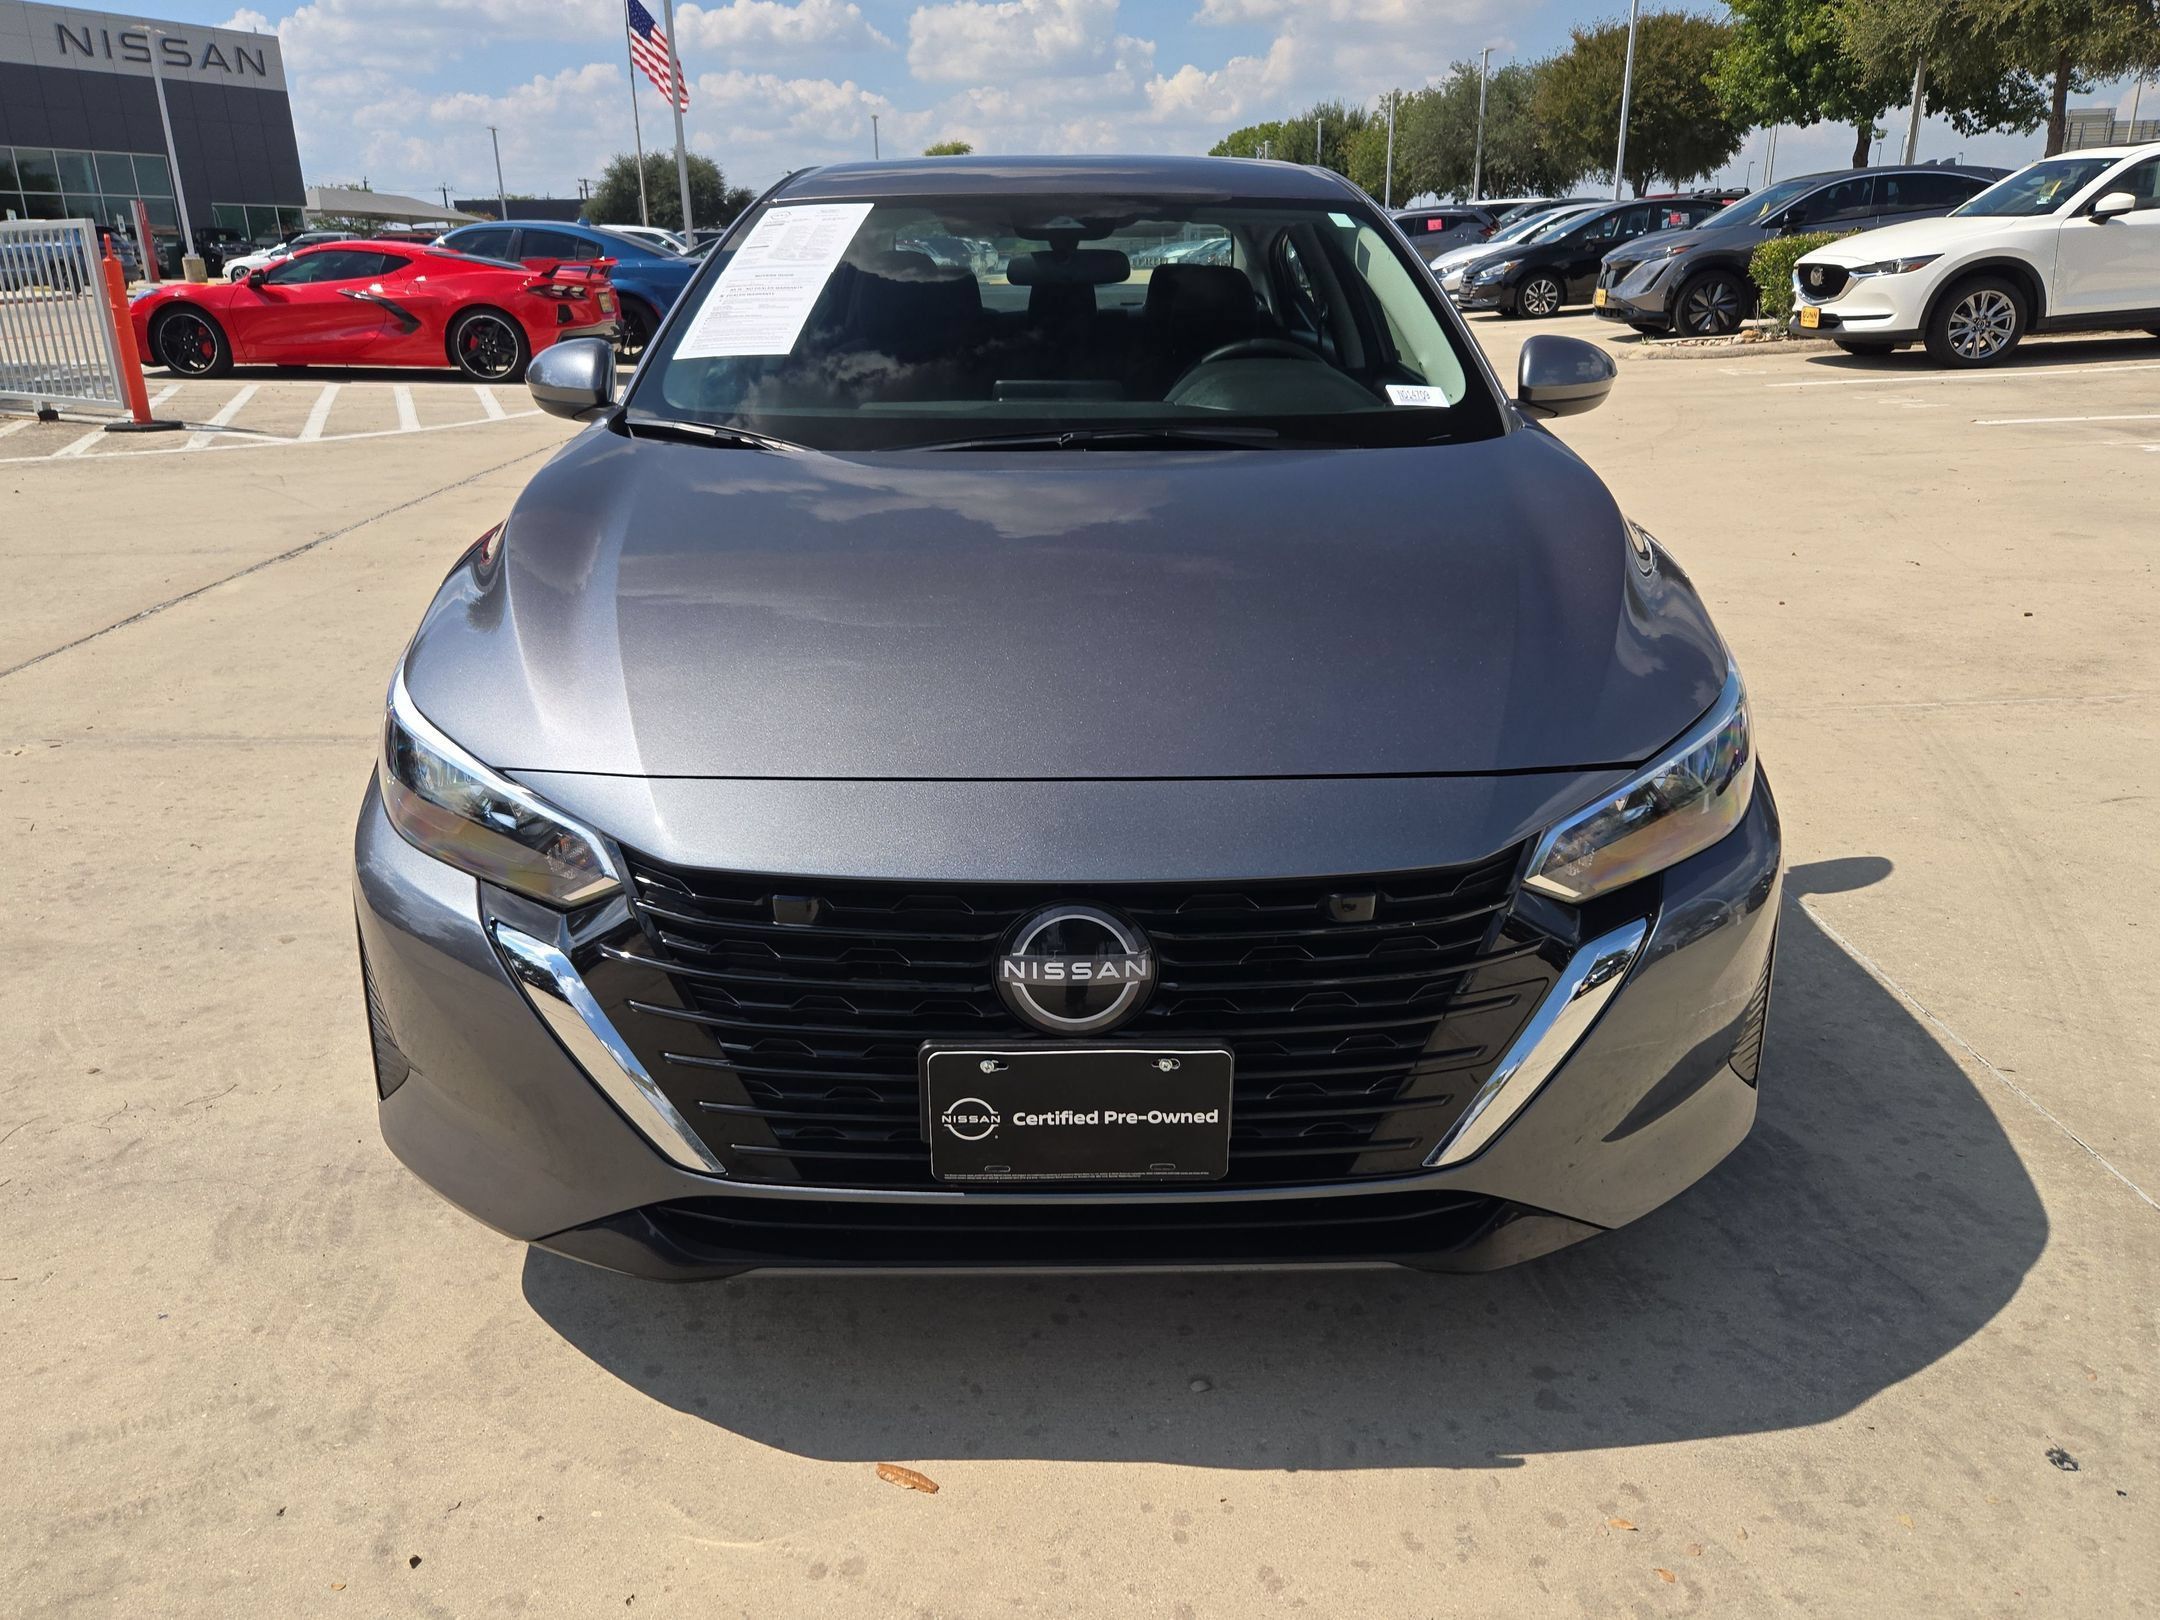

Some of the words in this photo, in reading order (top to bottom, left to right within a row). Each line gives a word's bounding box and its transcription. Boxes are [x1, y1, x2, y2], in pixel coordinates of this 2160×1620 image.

[55, 23, 266, 76] NISSAN
[1004, 959, 1146, 980] NISSAN
[942, 1114, 1000, 1124] NISSAN
[1012, 1110, 1099, 1126] Certified
[1104, 1109, 1219, 1125] Pre-Owned
